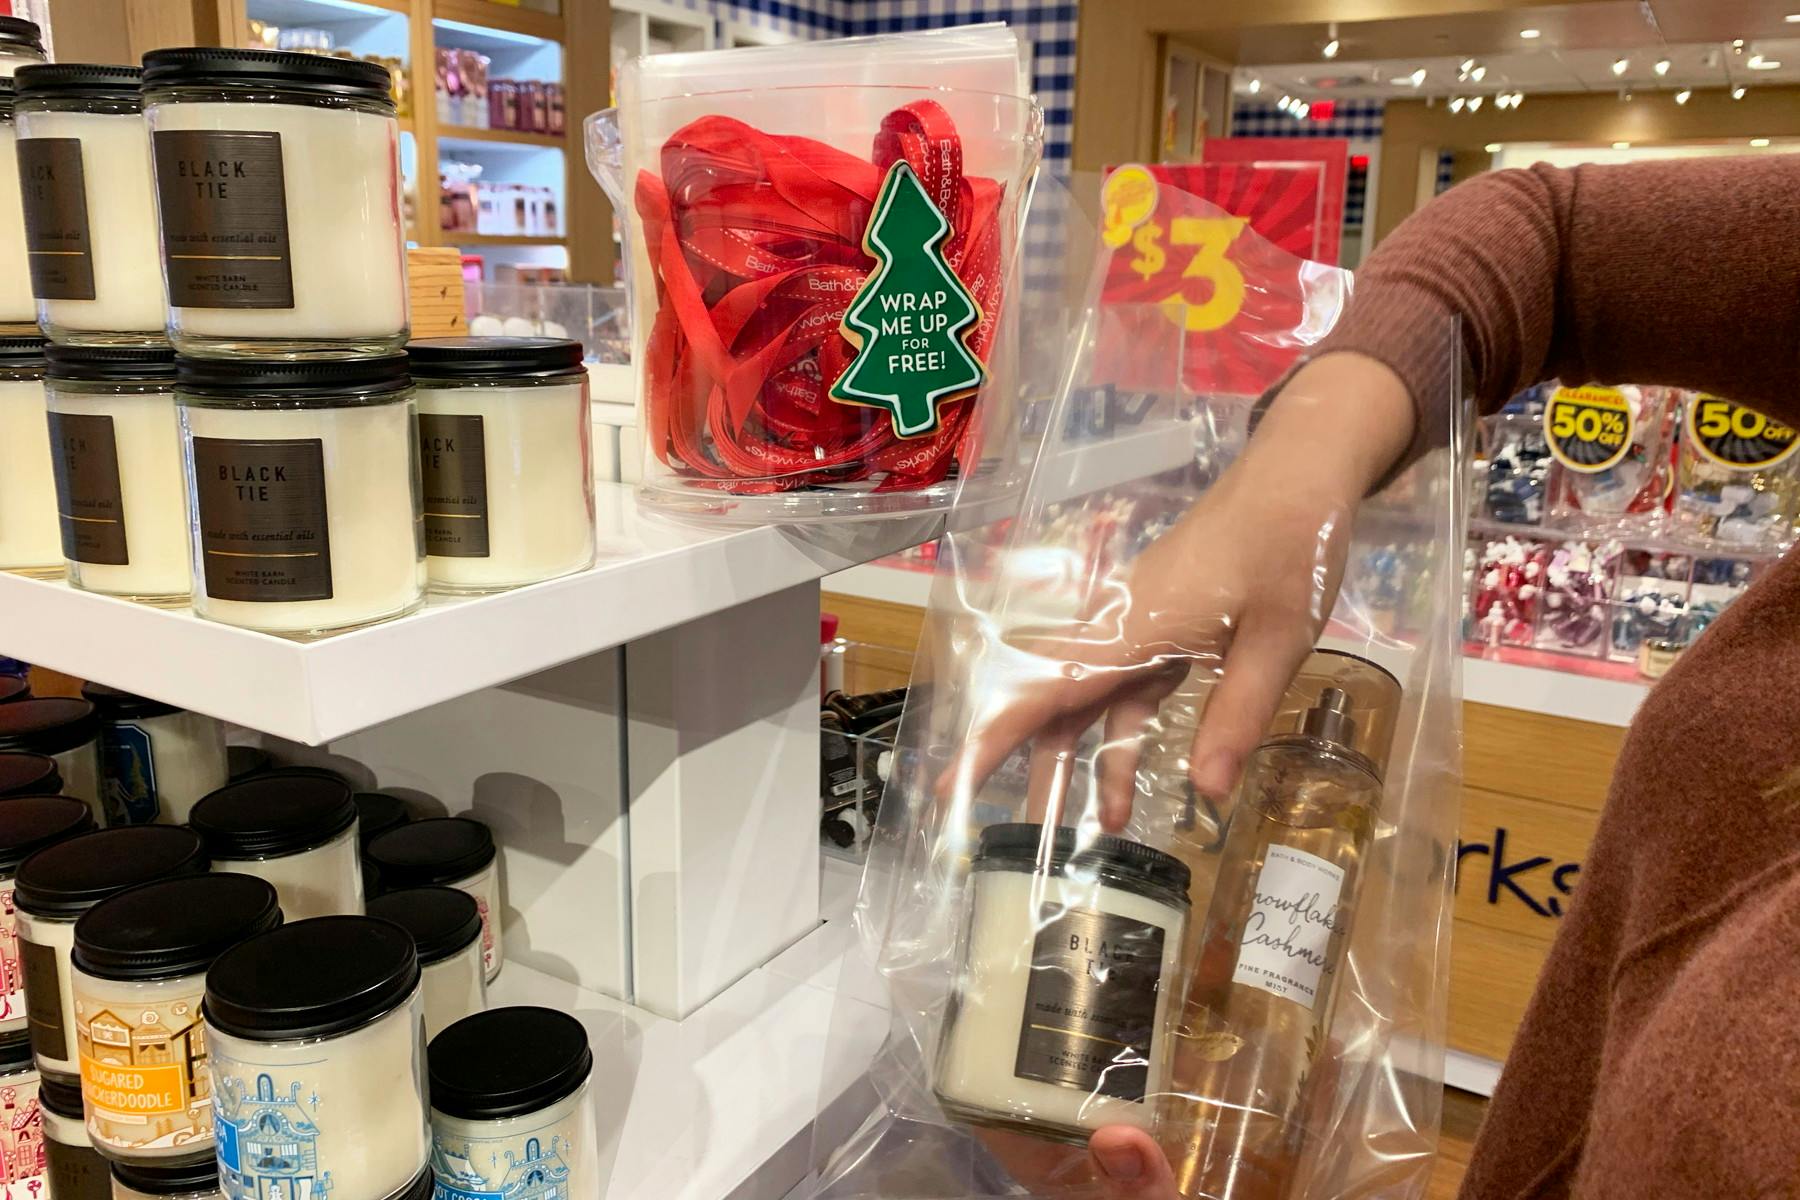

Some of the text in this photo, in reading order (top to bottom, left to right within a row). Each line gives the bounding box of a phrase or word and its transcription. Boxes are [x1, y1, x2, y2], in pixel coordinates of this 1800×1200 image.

[178, 161, 246, 178] BLACK
[196, 182, 228, 199] TIE
[212, 232, 254, 244] essential
[257, 234, 277, 244] oils
[880, 291, 947, 313] WRAP
[882, 313, 948, 336] ME UP
[902, 338, 929, 350] FOR
[888, 350, 946, 374] FREE!
[1552, 404, 1624, 442] 50%
[1700, 402, 1766, 439] 50
[1599, 432, 1625, 446] OFF
[896, 445, 940, 470] Works
[219, 465, 287, 482] BLACK
[236, 485, 269, 501] TIE
[462, 496, 477, 504] oils
[229, 529, 249, 541] with
[252, 530, 294, 541] essential
[296, 530, 315, 540] oils
[1297, 859, 1316, 869] BODY
[1239, 963, 1315, 996] FINE FRAGRANCE
[1265, 980, 1288, 994] MIST
[1064, 1006, 1088, 1020] with
[1062, 1050, 1090, 1062] WHITE
[1050, 1057, 1091, 1073] SCENTED
